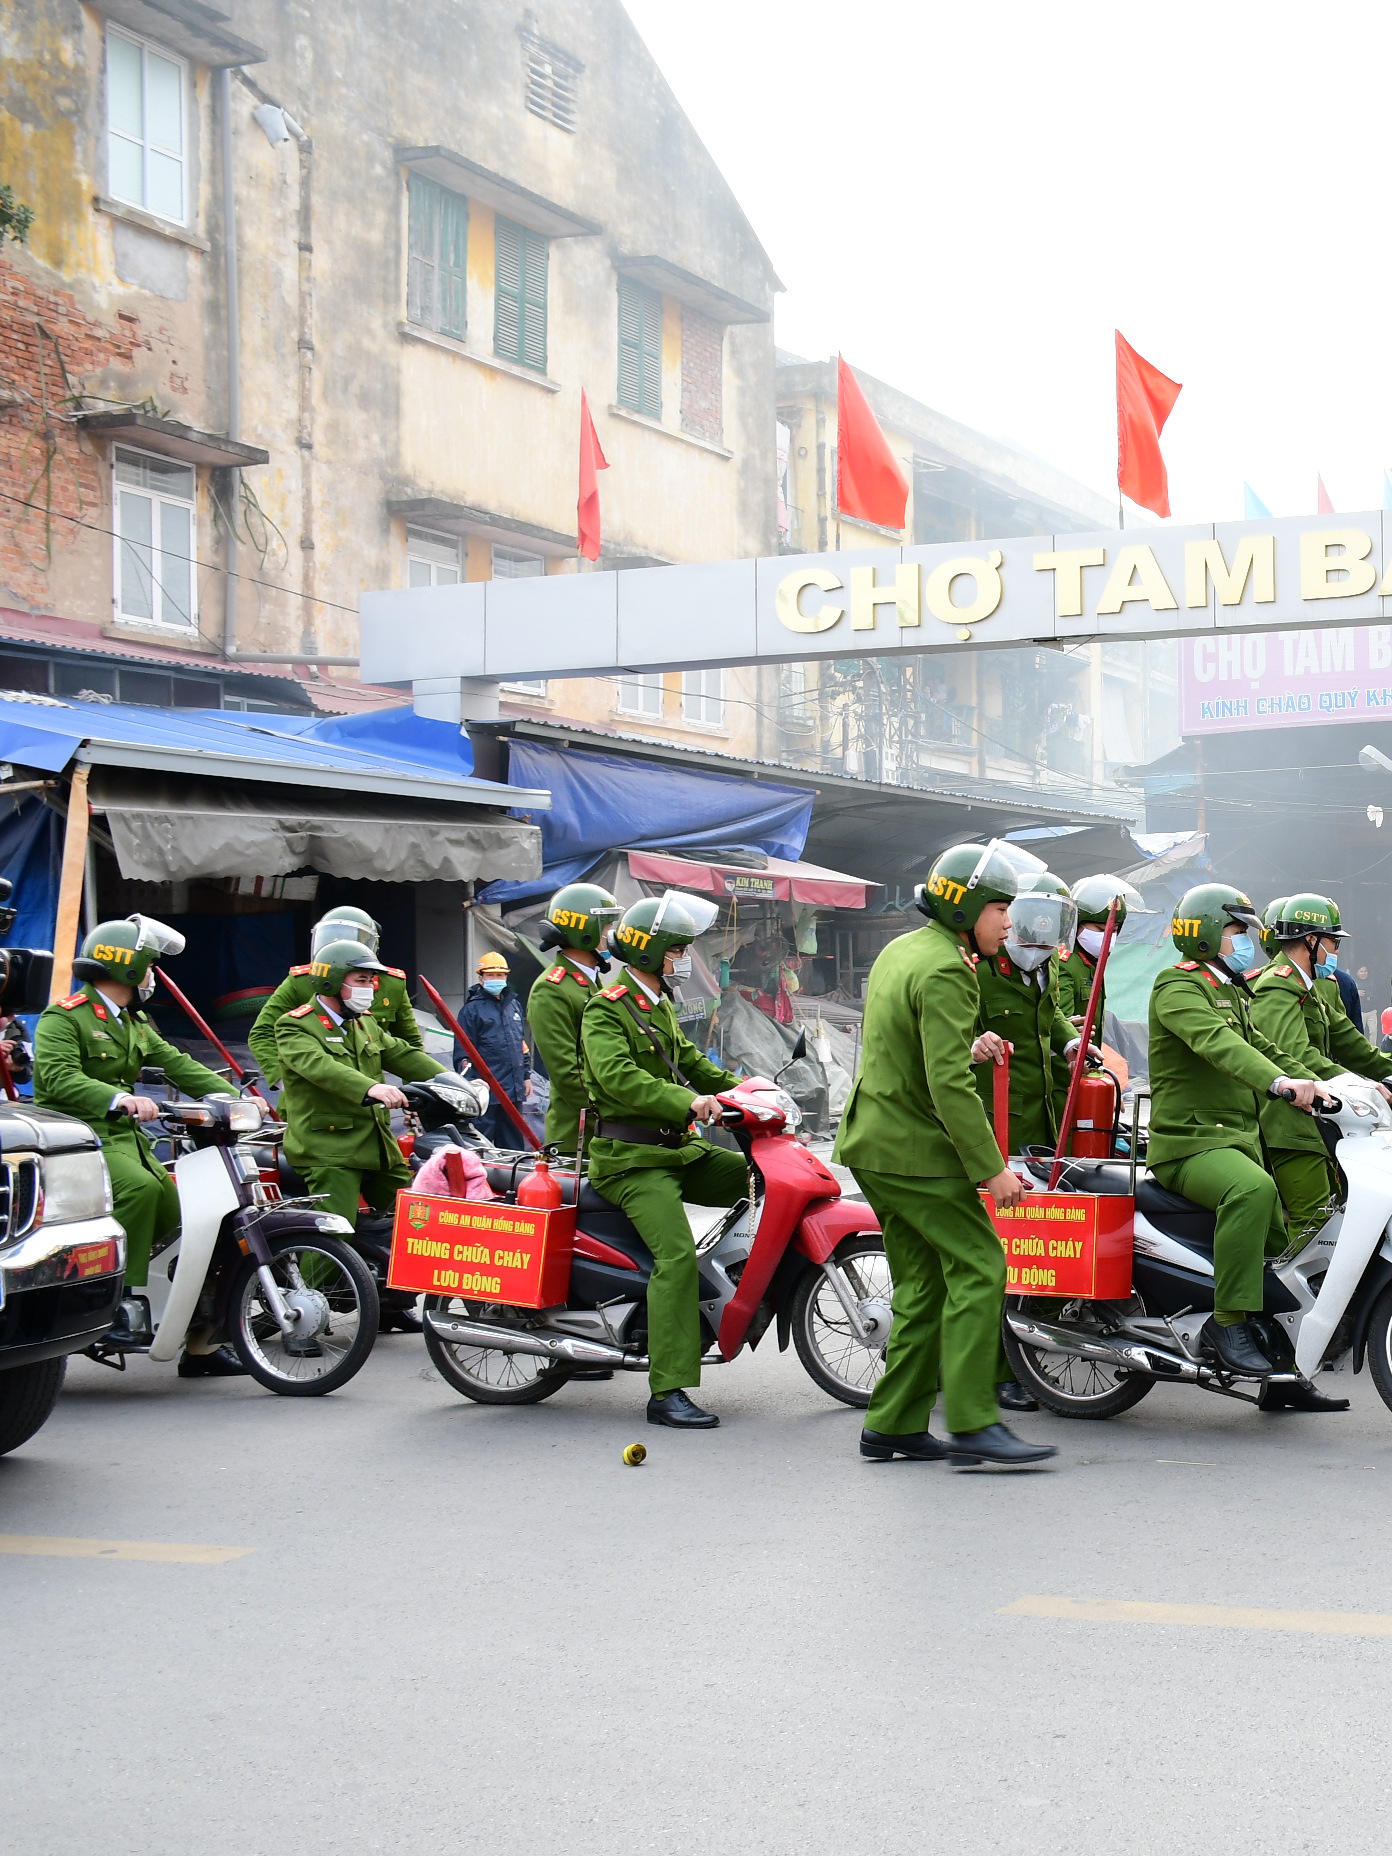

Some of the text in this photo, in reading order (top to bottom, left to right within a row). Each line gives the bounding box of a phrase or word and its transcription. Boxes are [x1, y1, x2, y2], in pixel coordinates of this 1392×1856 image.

[775, 549, 1004, 642] CHỢ
[1033, 535, 1277, 618] TAM
[1278, 627, 1355, 677] TAM
[1200, 696, 1249, 720] KÍNH
[1256, 692, 1312, 715] CHÀO
[1319, 687, 1359, 713] QUÝ
[928, 872, 968, 905] CSTT
[552, 908, 589, 931] CSTT
[1294, 910, 1328, 924] CSTT
[617, 923, 652, 951] CSTT
[93, 944, 135, 965] CSTT
[439, 1210, 459, 1225] CÔNG
[460, 1215, 471, 1226] AN
[472, 1215, 492, 1230] QUẬN
[1015, 1207, 1025, 1218] AN
[1026, 1205, 1045, 1220] QUẬN
[406, 1237, 531, 1269] THÙNG CHỮA CHÁY
[1011, 1235, 1045, 1256] CHỮA
[1048, 1238, 1083, 1258] CHÁY
[433, 1269, 501, 1294] LƯU ĐỘNG
[1021, 1265, 1056, 1288] ĐỘNG
